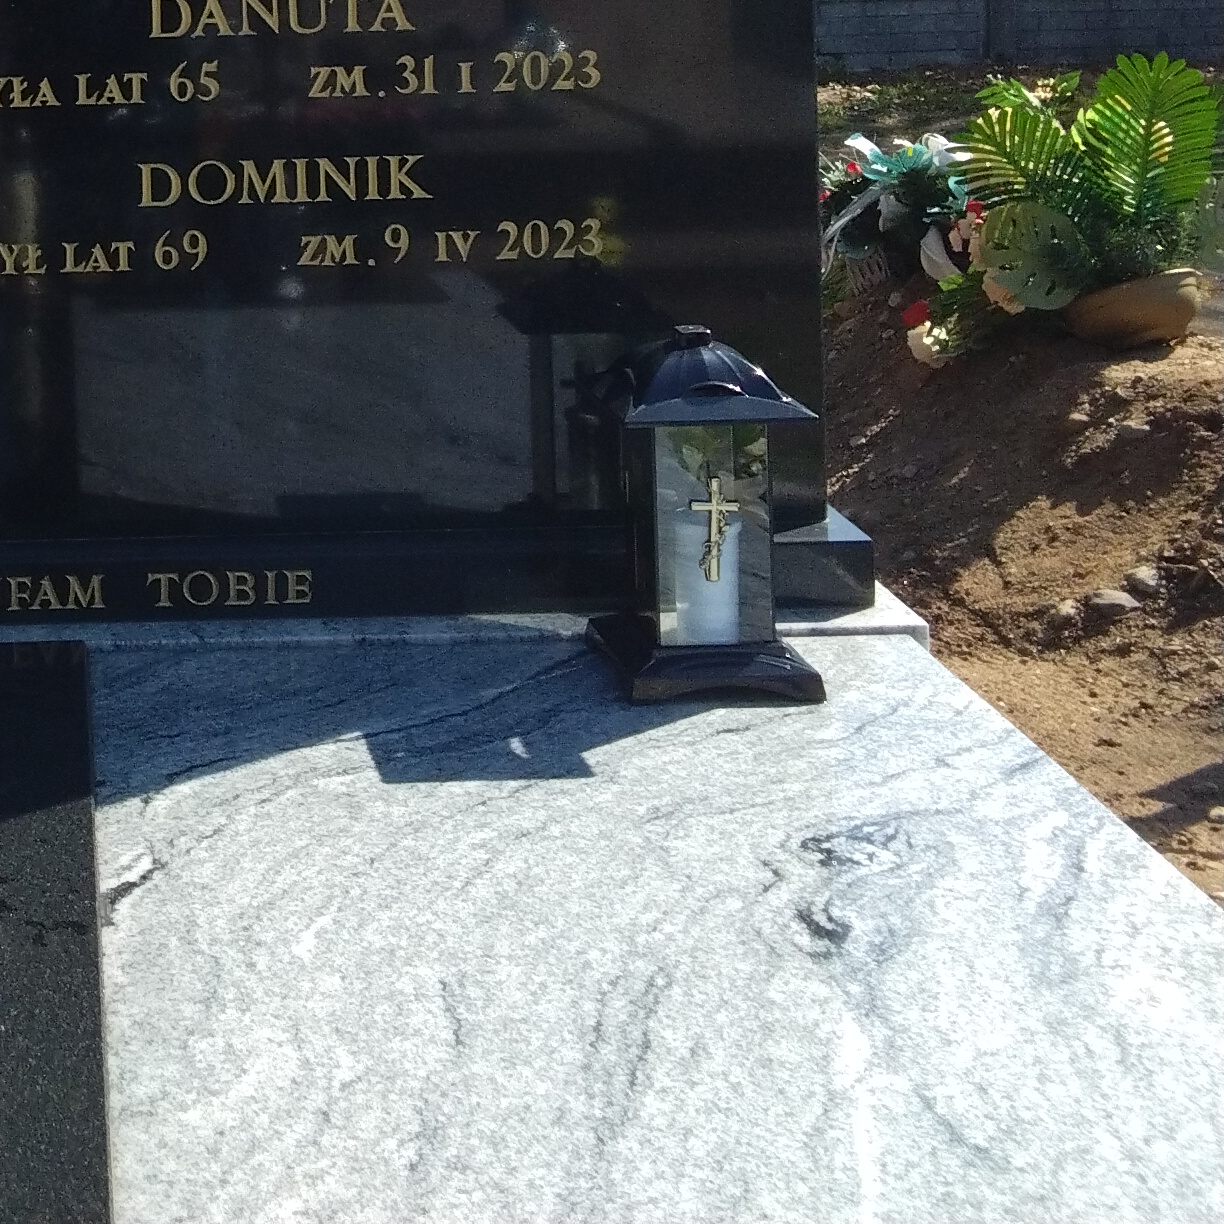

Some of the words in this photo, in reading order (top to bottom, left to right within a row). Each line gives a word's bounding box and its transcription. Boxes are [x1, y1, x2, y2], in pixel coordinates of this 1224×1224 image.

[74, 72, 148, 105] LAT
[169, 59, 220, 103] 65
[457, 62, 477, 93] I
[492, 49, 601, 92] 2023
[136, 154, 434, 207] DOMINIK
[60, 241, 136, 273] LAT
[154, 229, 208, 271] 69
[434, 230, 480, 262] IV
[496, 218, 603, 260] 2023
[146, 570, 313, 608] TOBIE
